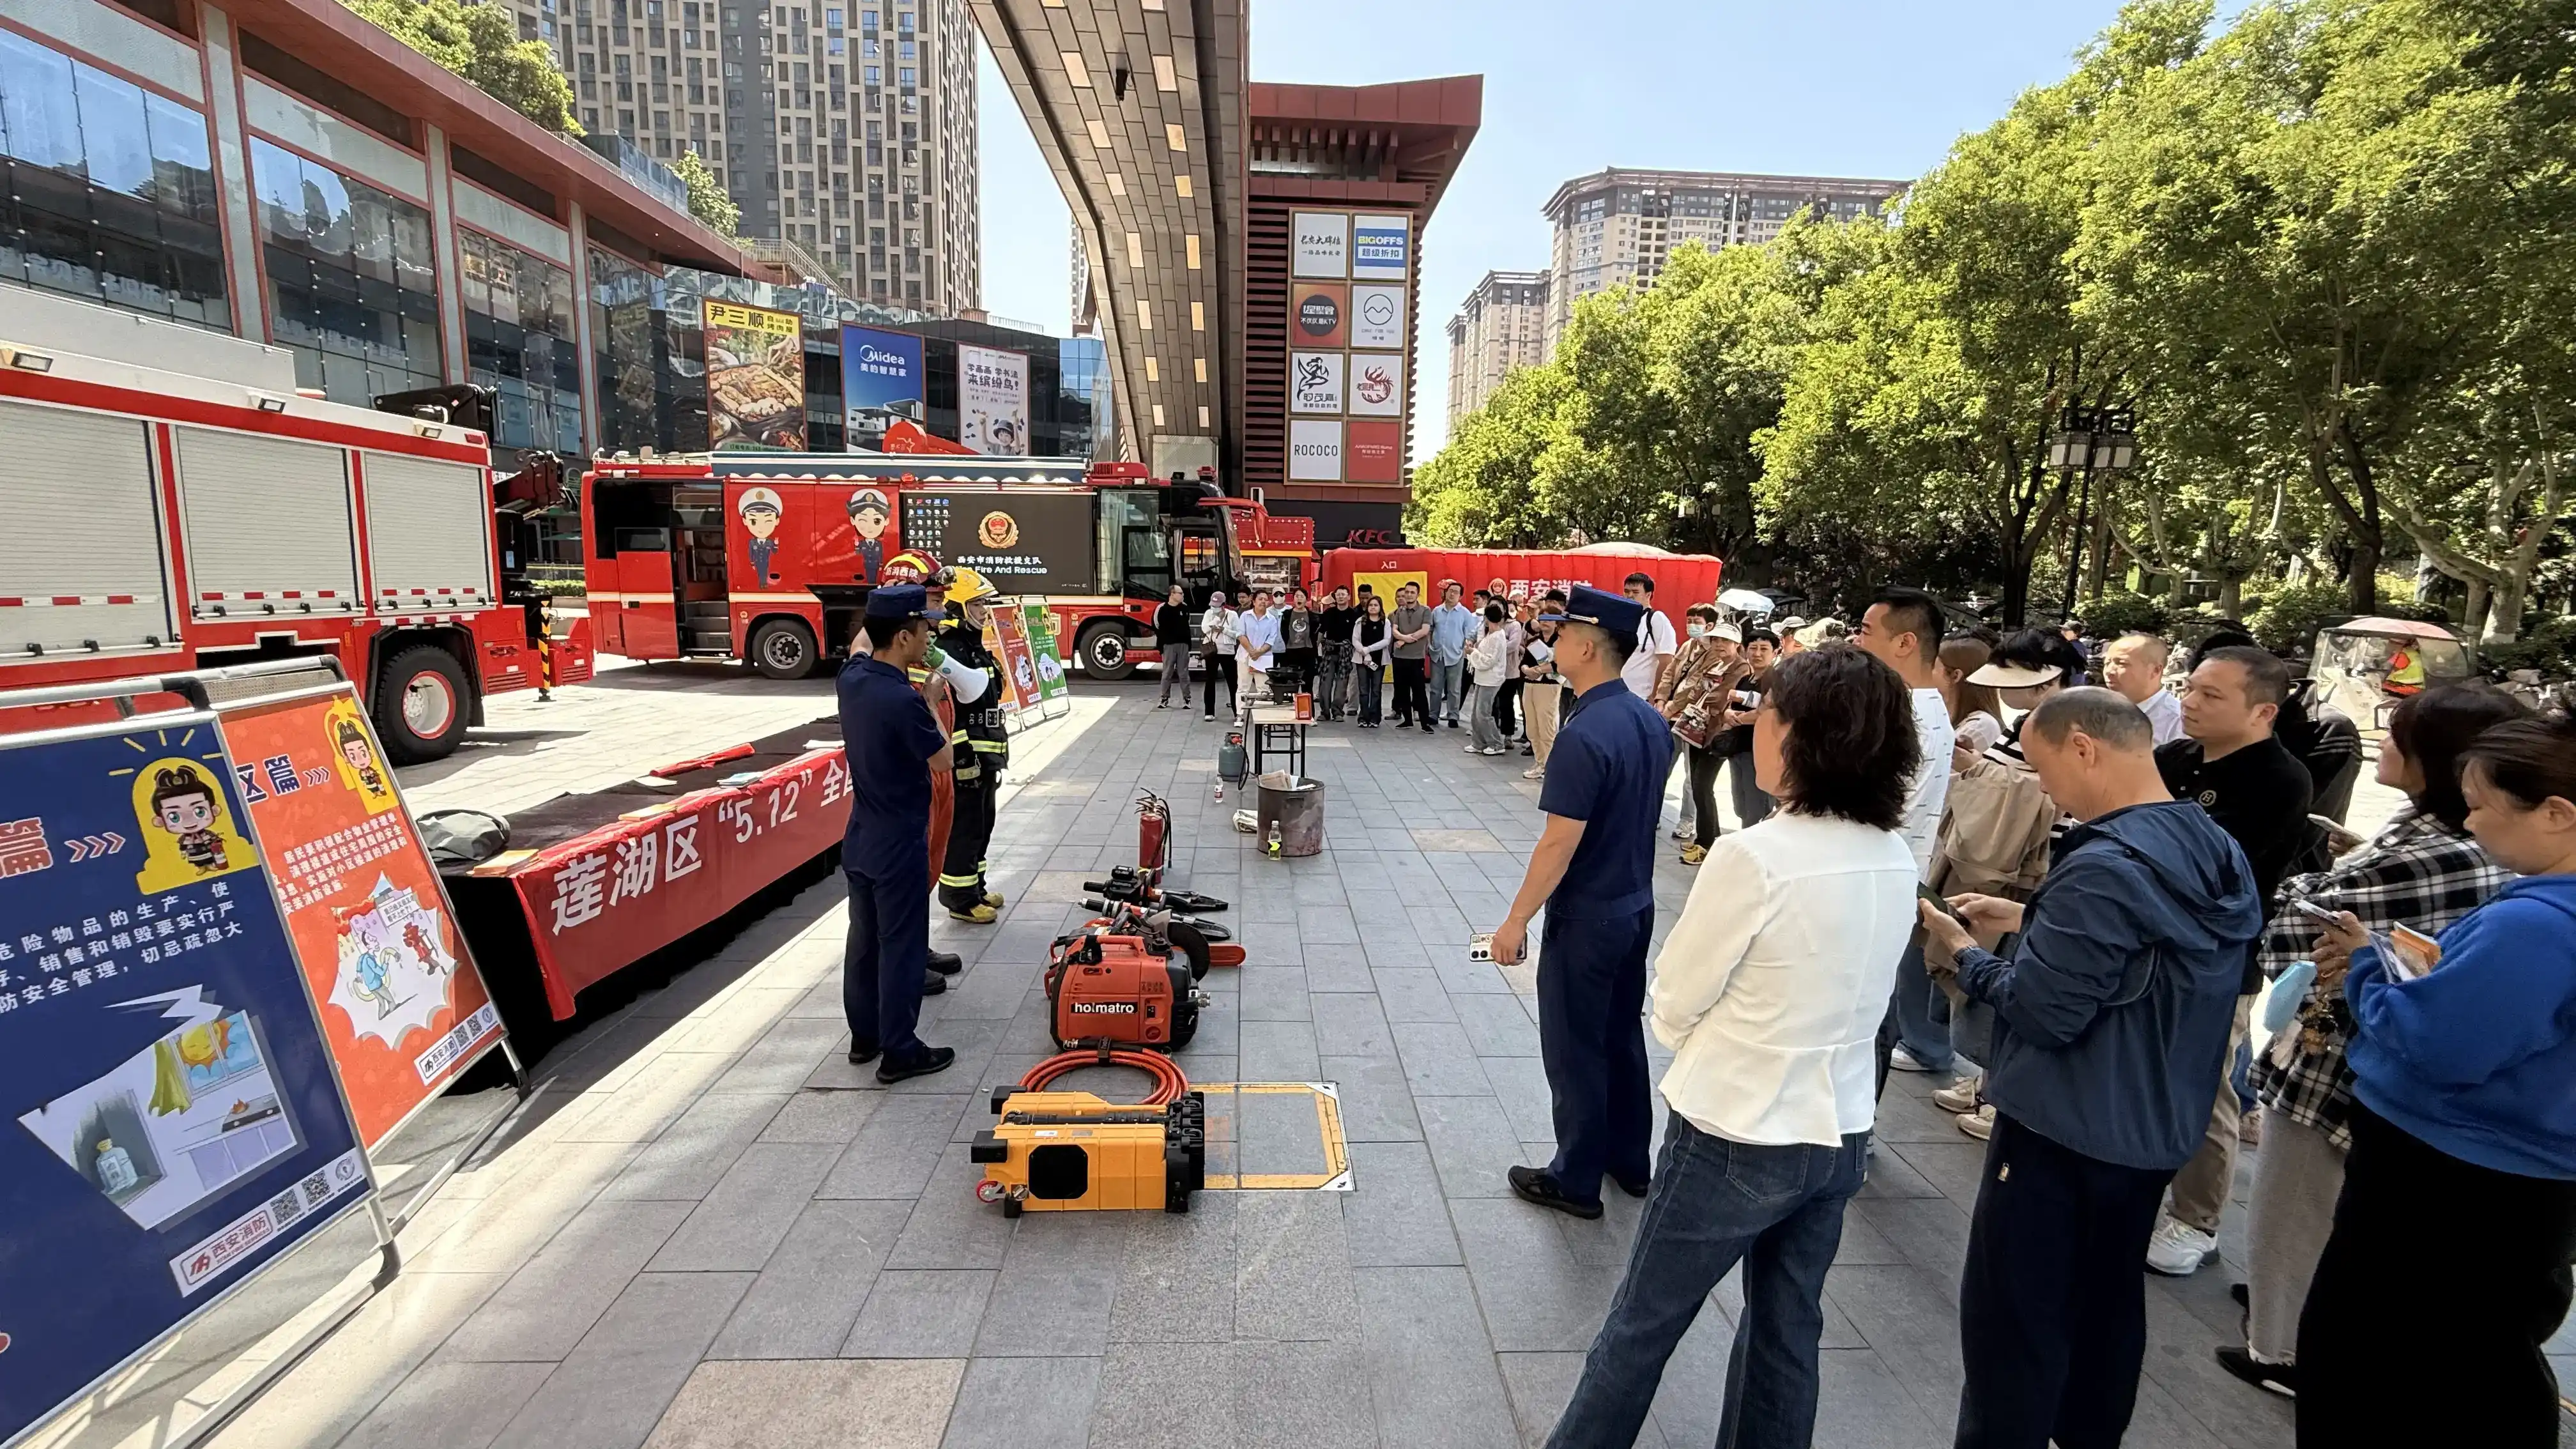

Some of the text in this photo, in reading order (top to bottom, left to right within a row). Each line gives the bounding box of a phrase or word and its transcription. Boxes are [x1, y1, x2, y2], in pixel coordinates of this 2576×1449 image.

[1358, 236, 1404, 245] BIGOFFS
[1361, 249, 1399, 257] 超级折扣
[710, 305, 764, 328] 尹三顺
[860, 345, 905, 365] Midea
[860, 362, 907, 377] 美的智慧家
[1294, 445, 1338, 456] ROCOCO
[1347, 529, 1392, 544] KFC
[957, 556, 1042, 565] 西安市消防救援支队
[1381, 561, 1397, 569] 入口
[1075, 1002, 1135, 1013] holmatro
[211, 1216, 267, 1259] 西安消防
